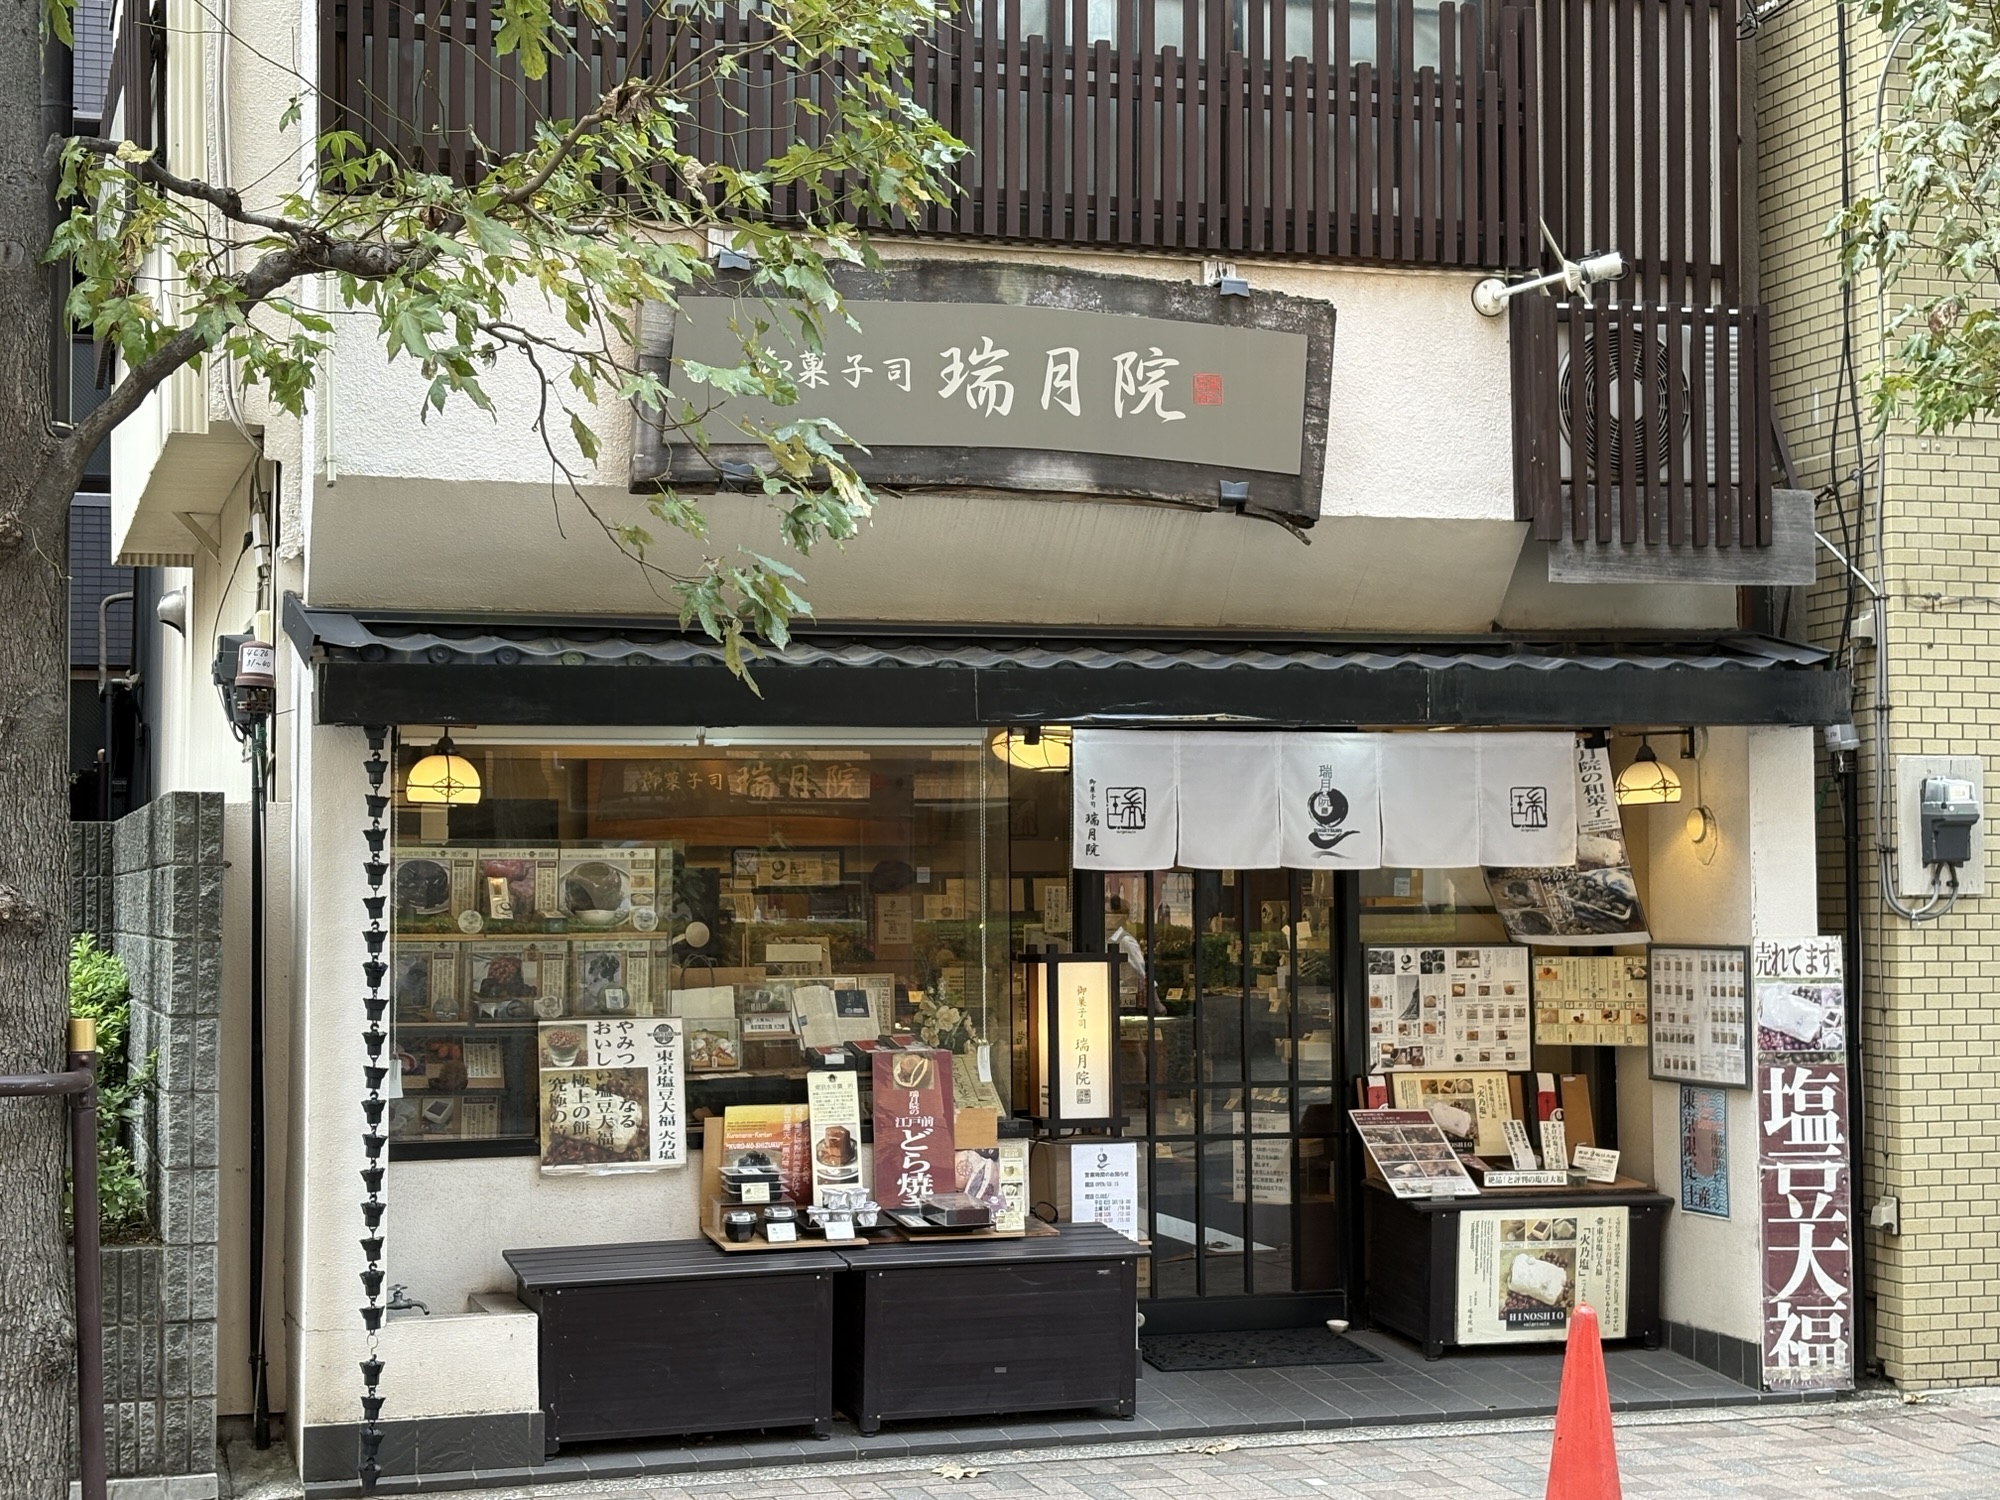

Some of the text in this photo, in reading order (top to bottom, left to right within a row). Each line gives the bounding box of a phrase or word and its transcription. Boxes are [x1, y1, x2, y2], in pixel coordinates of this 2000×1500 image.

[938, 336, 1186, 423] 瑞月院
[735, 761, 863, 801] 瑞月院
[1319, 764, 1333, 808] 瑞月院
[1085, 812, 1100, 857] 瑞月院
[1075, 1037, 1091, 1085] 瑞月院
[656, 1049, 676, 1127] 東京塩豆大福
[658, 1130, 677, 1160] 火乃塩
[894, 1116, 934, 1128] 江戸前
[1762, 1067, 1849, 1369] 塩豆大福
[1578, 1227, 1591, 1277] 「火乃塩」
[1595, 1227, 1604, 1276] 東京塩豆大福
[1509, 1311, 1564, 1321] HINOSHIO
